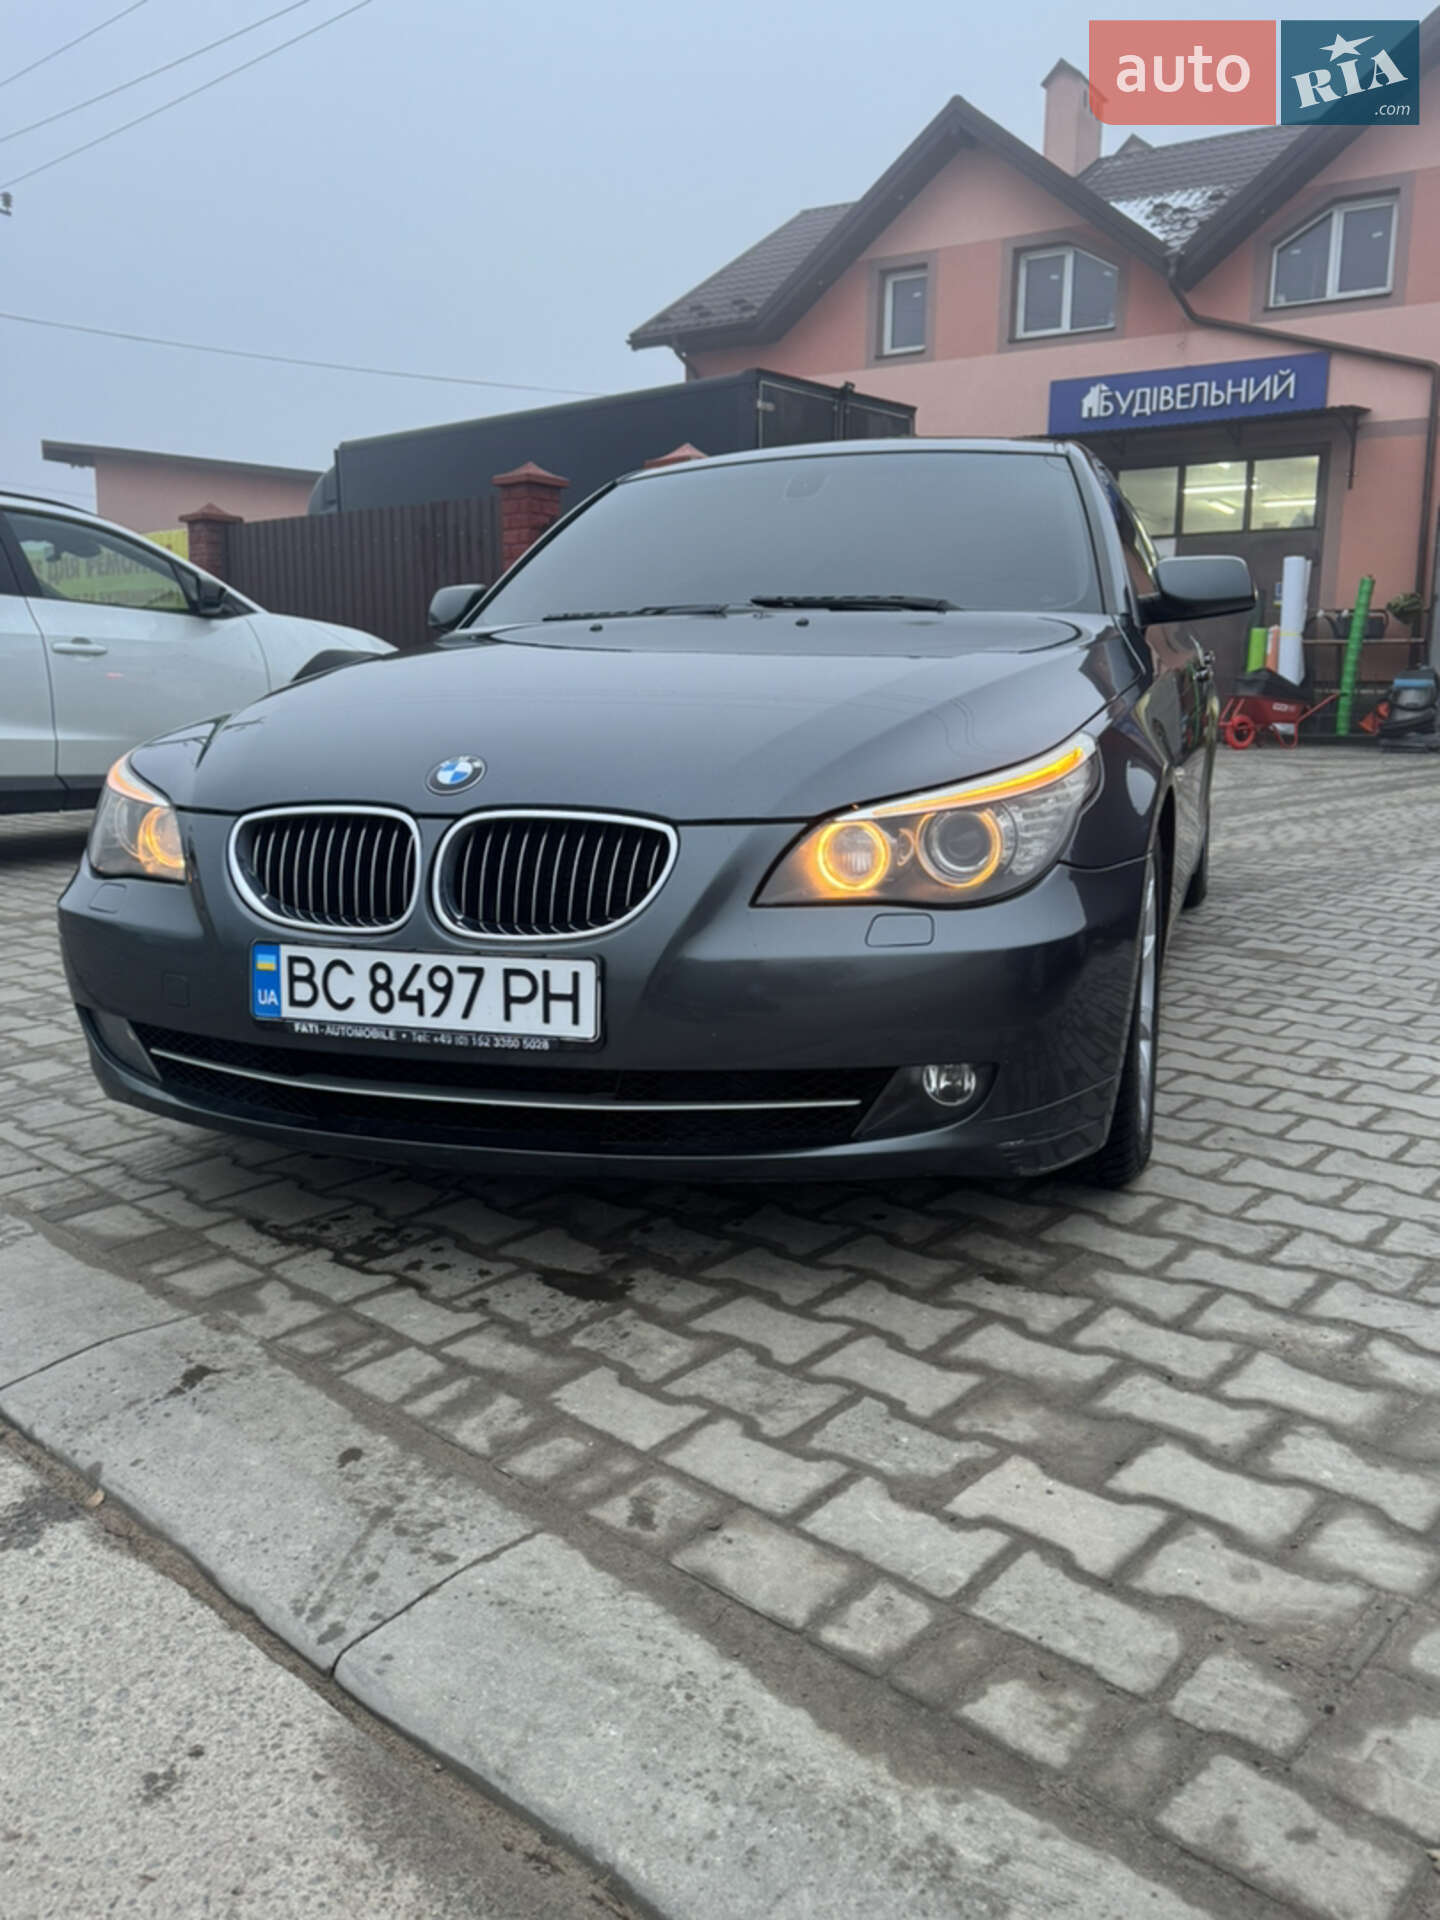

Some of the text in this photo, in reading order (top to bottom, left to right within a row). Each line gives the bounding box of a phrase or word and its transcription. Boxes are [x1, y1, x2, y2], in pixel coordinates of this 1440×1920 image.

[1099, 369, 1296, 417] БУДІВЕЛЬНИЙ
[257, 989, 279, 1005] UA
[368, 961, 485, 1020] 8497
